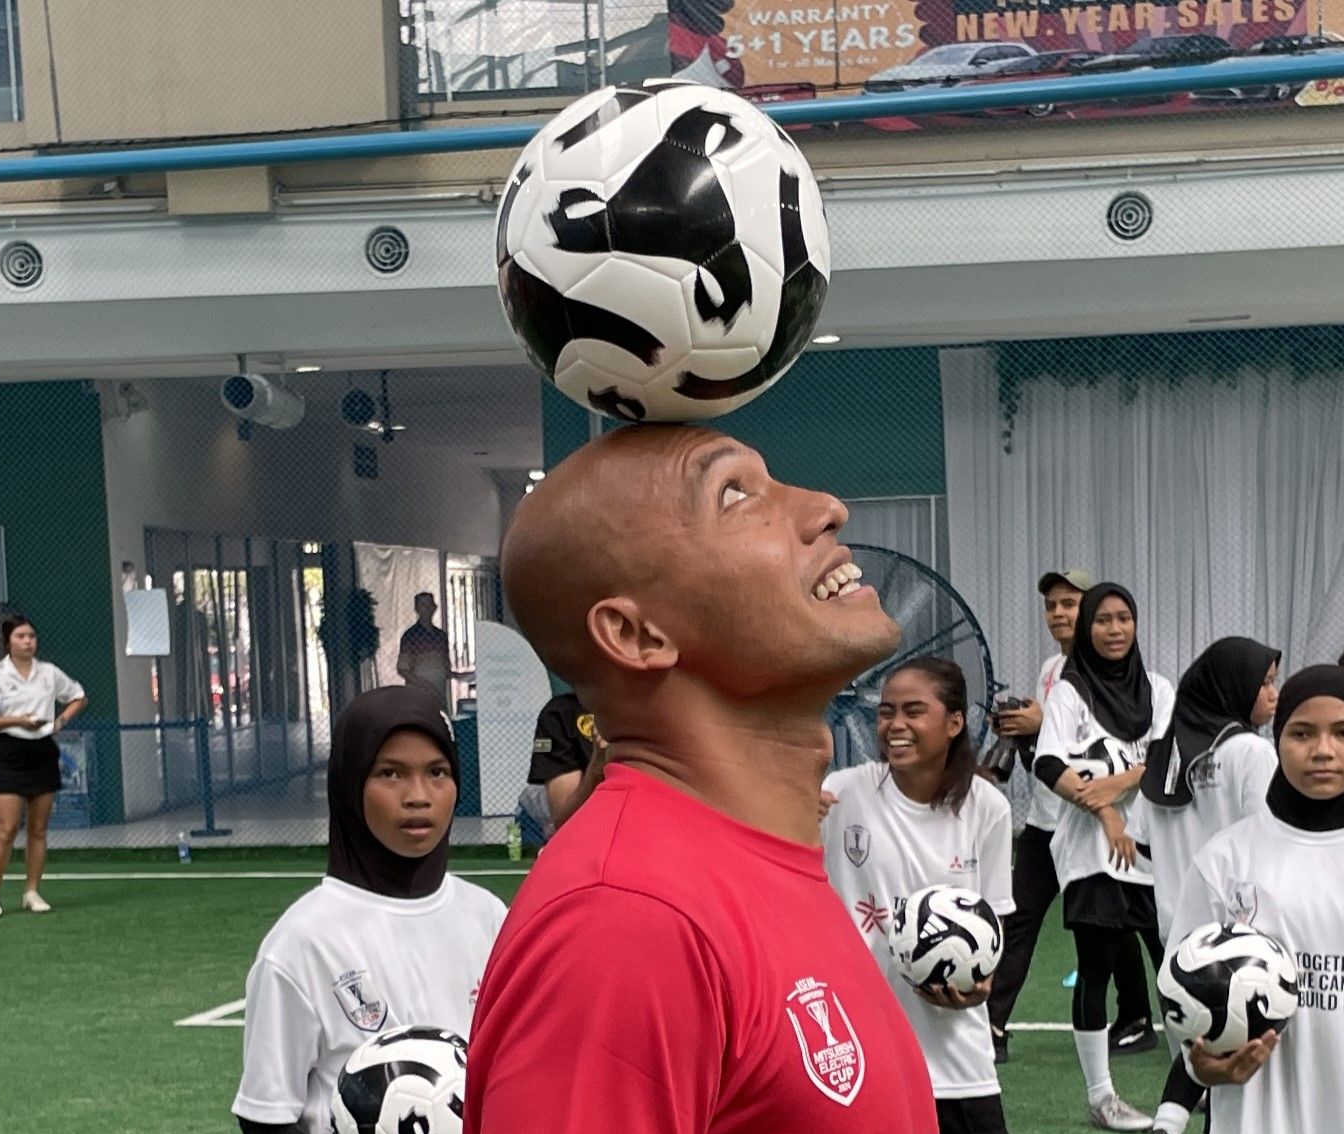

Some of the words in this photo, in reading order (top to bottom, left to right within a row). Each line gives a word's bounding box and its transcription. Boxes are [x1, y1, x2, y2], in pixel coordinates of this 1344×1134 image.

[748, 3, 889, 26] WARRANTY
[726, 31, 782, 58] 5+1
[793, 23, 916, 54] YEARS
[1297, 972, 1314, 989] WE
[1297, 991, 1338, 1011] BUILD
[829, 1066, 855, 1086] CUP
